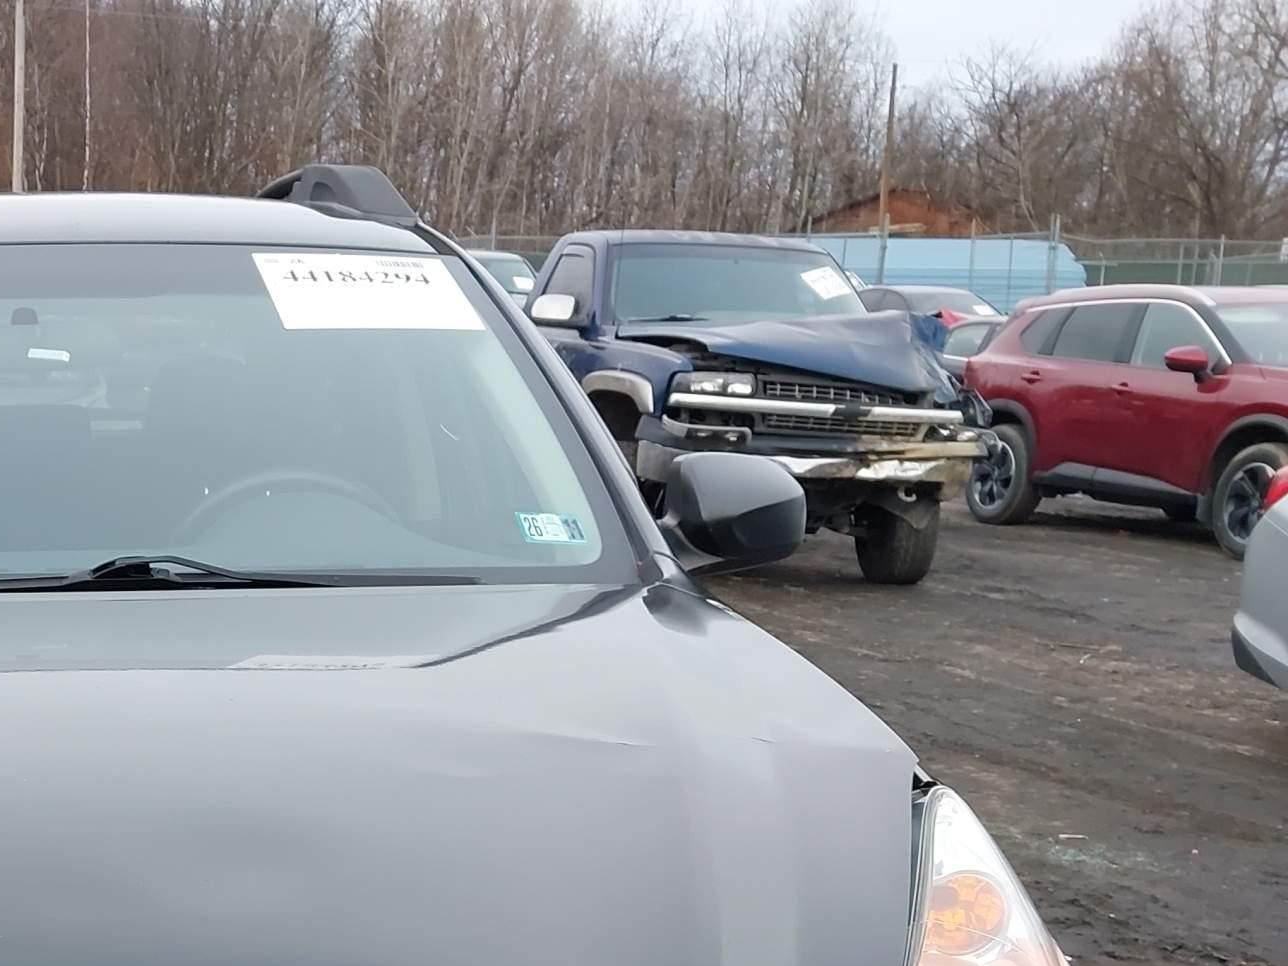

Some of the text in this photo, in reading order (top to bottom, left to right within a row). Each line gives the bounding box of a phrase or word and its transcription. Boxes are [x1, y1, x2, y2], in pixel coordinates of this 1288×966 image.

[283, 269, 431, 286] 44184294
[523, 516, 585, 541] 26 11
